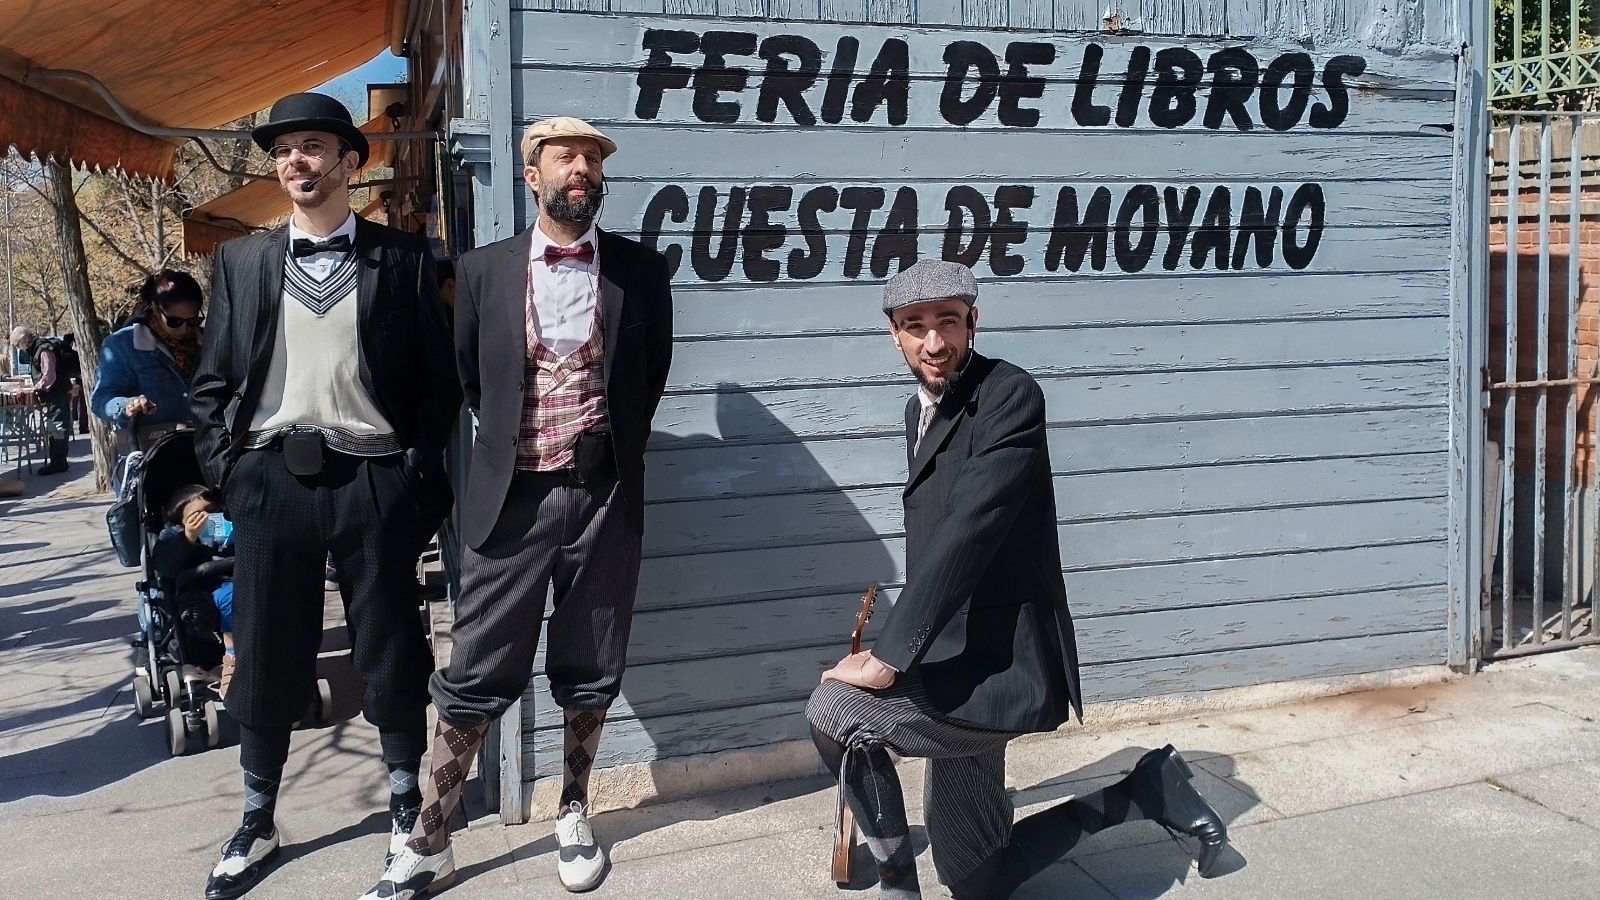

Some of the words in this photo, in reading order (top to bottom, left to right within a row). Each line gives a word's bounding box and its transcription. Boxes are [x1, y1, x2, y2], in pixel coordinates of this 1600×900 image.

[635, 29, 909, 126] FERIA
[940, 40, 1055, 127] DE
[1072, 43, 1366, 131] LIBROS
[641, 184, 918, 281] CUESTA
[943, 185, 1034, 276] DE
[1045, 183, 1325, 273] MOYANO
